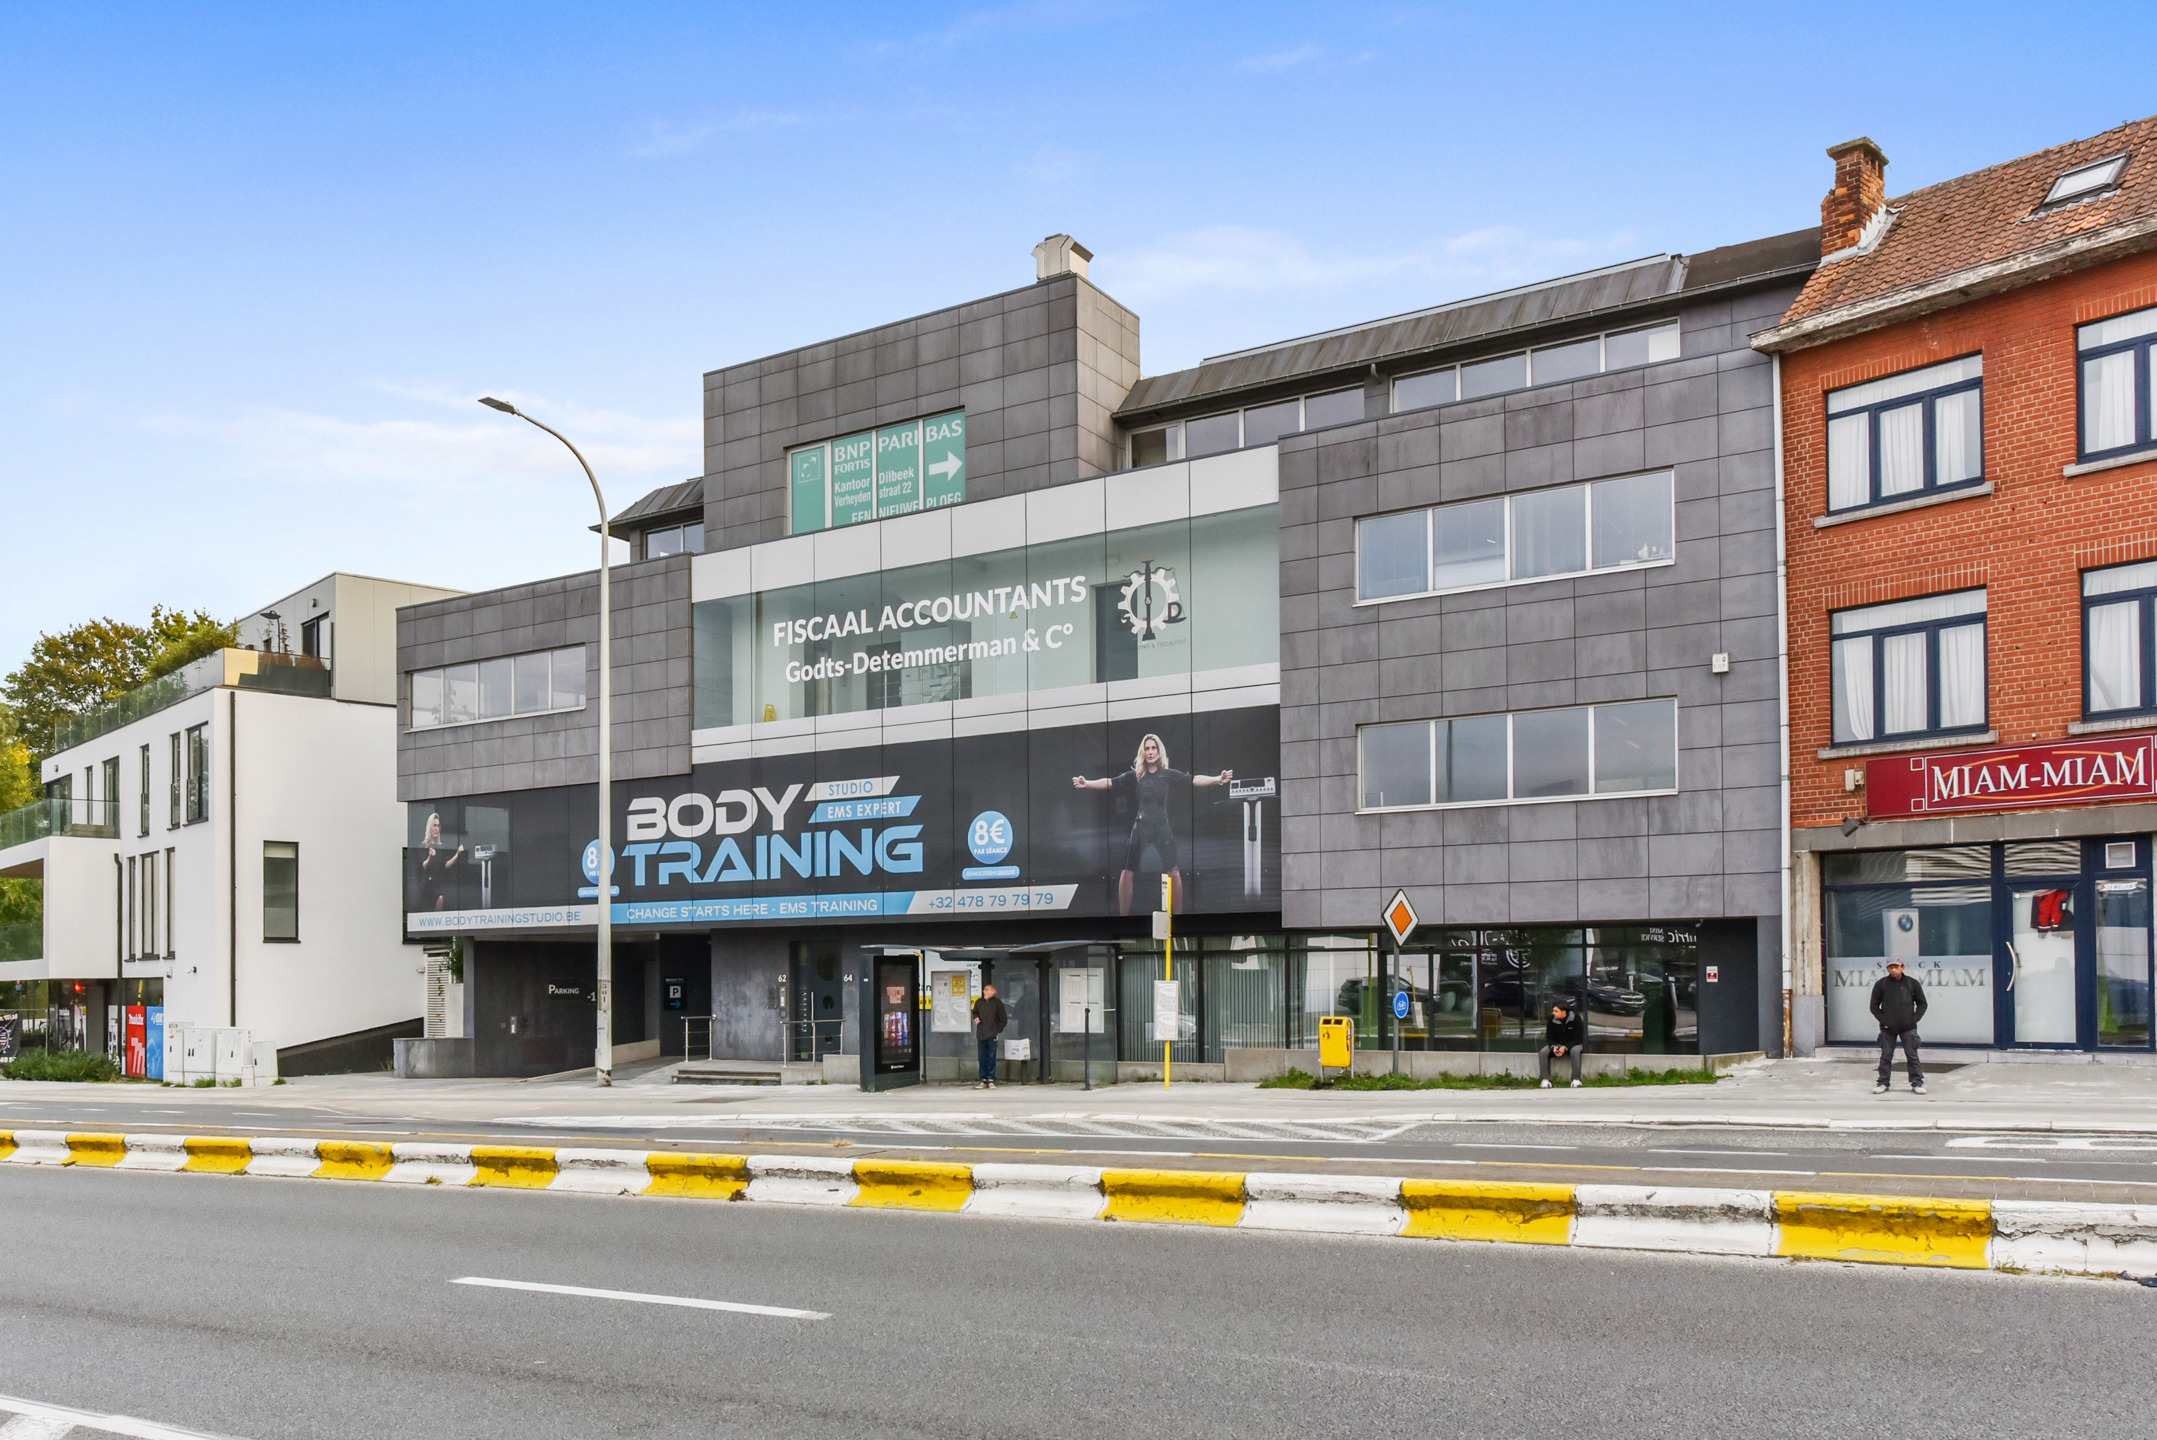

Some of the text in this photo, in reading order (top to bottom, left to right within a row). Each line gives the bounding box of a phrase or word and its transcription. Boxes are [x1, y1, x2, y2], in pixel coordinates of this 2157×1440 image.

[835, 441, 871, 462] BNP
[835, 458, 871, 474] FORTIS
[835, 466, 915, 493] Kantoor Dilbeek
[902, 481, 912, 493] 22
[774, 575, 1087, 647] FISCAAL ACCOUNTANTS
[785, 637, 1017, 683] Godts-Detemmerman
[1022, 628, 1041, 652] &
[1932, 747, 2148, 803] MIAM-MIAM
[828, 780, 873, 796] STUDIO
[626, 783, 804, 841] BODY
[827, 801, 902, 819] EMS EXPERT
[974, 819, 1005, 846] 8€
[587, 847, 600, 869] 8
[621, 824, 924, 886] TRAINING
[627, 906, 677, 920] CHANGE
[681, 904, 730, 918] STARTS
[733, 903, 768, 916] HERE
[779, 901, 807, 914] EMS
[810, 899, 878, 913] TRAINING
[929, 892, 1054, 909] +32 478 79 79 79
[419, 911, 581, 927] WWW.BODYTRAININGSTUDIO.BE
[778, 974, 787, 983] 62
[843, 973, 853, 983] 64
[1834, 970, 1887, 987] MIA
[672, 987, 679, 996] P
